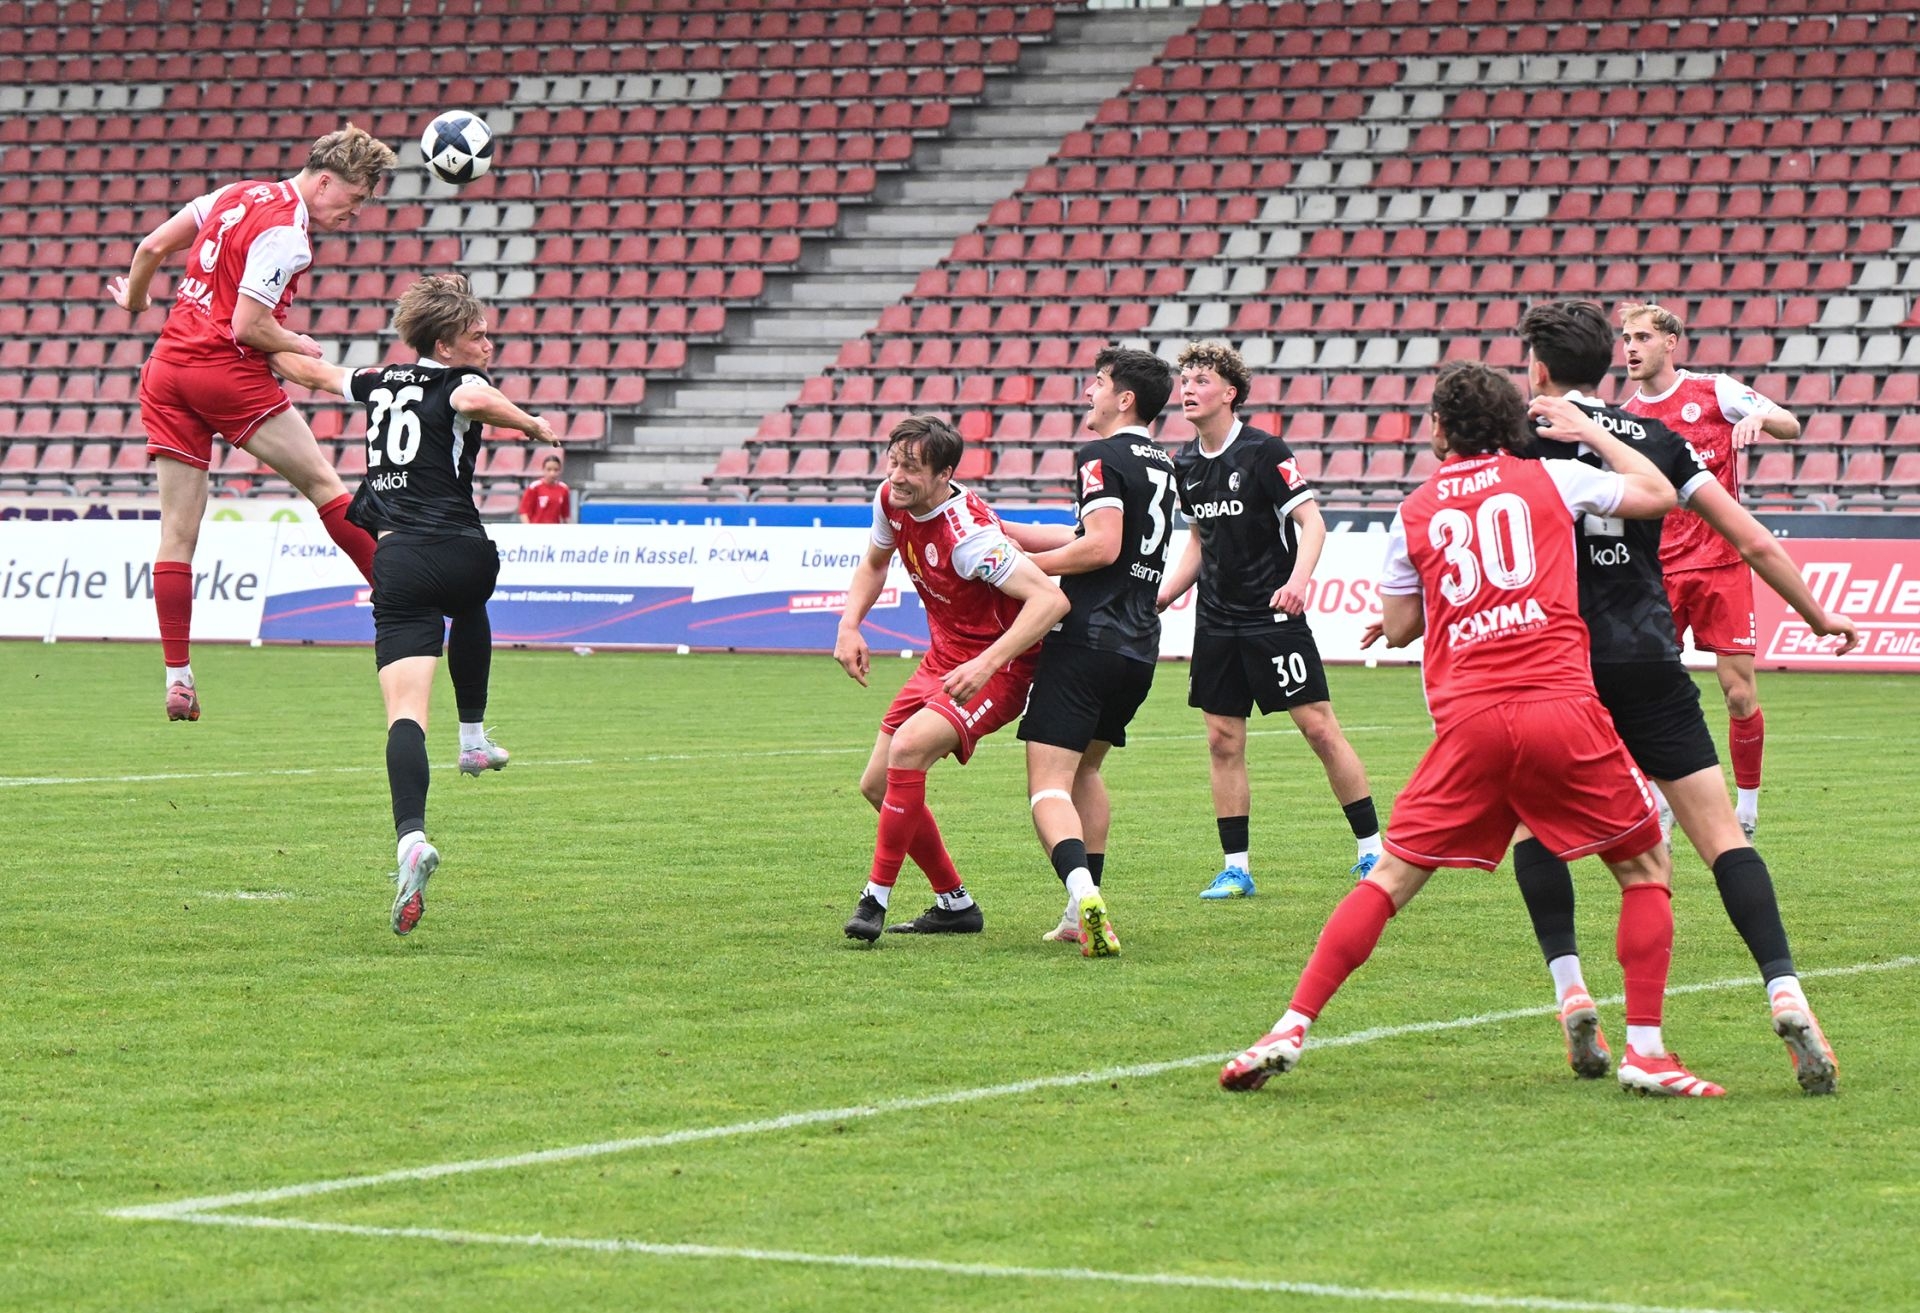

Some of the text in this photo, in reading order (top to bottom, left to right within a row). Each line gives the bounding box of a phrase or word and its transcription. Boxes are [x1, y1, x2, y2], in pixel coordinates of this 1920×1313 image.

[200, 203, 247, 273] 3
[367, 385, 424, 467] 26
[1592, 411, 1647, 440] iburg
[1436, 466, 1502, 501] STARK
[281, 544, 338, 557] POLYMA
[498, 545, 699, 565] echnik made in Kassel.
[708, 549, 770, 562] POLYMA
[1428, 492, 1537, 607] 30
[1590, 543, 1631, 566] koß
[0, 558, 258, 602] ische Wrke
[1448, 598, 1548, 648] POLYMA
[1781, 629, 1872, 655] 3423
[1271, 651, 1308, 688] 30
